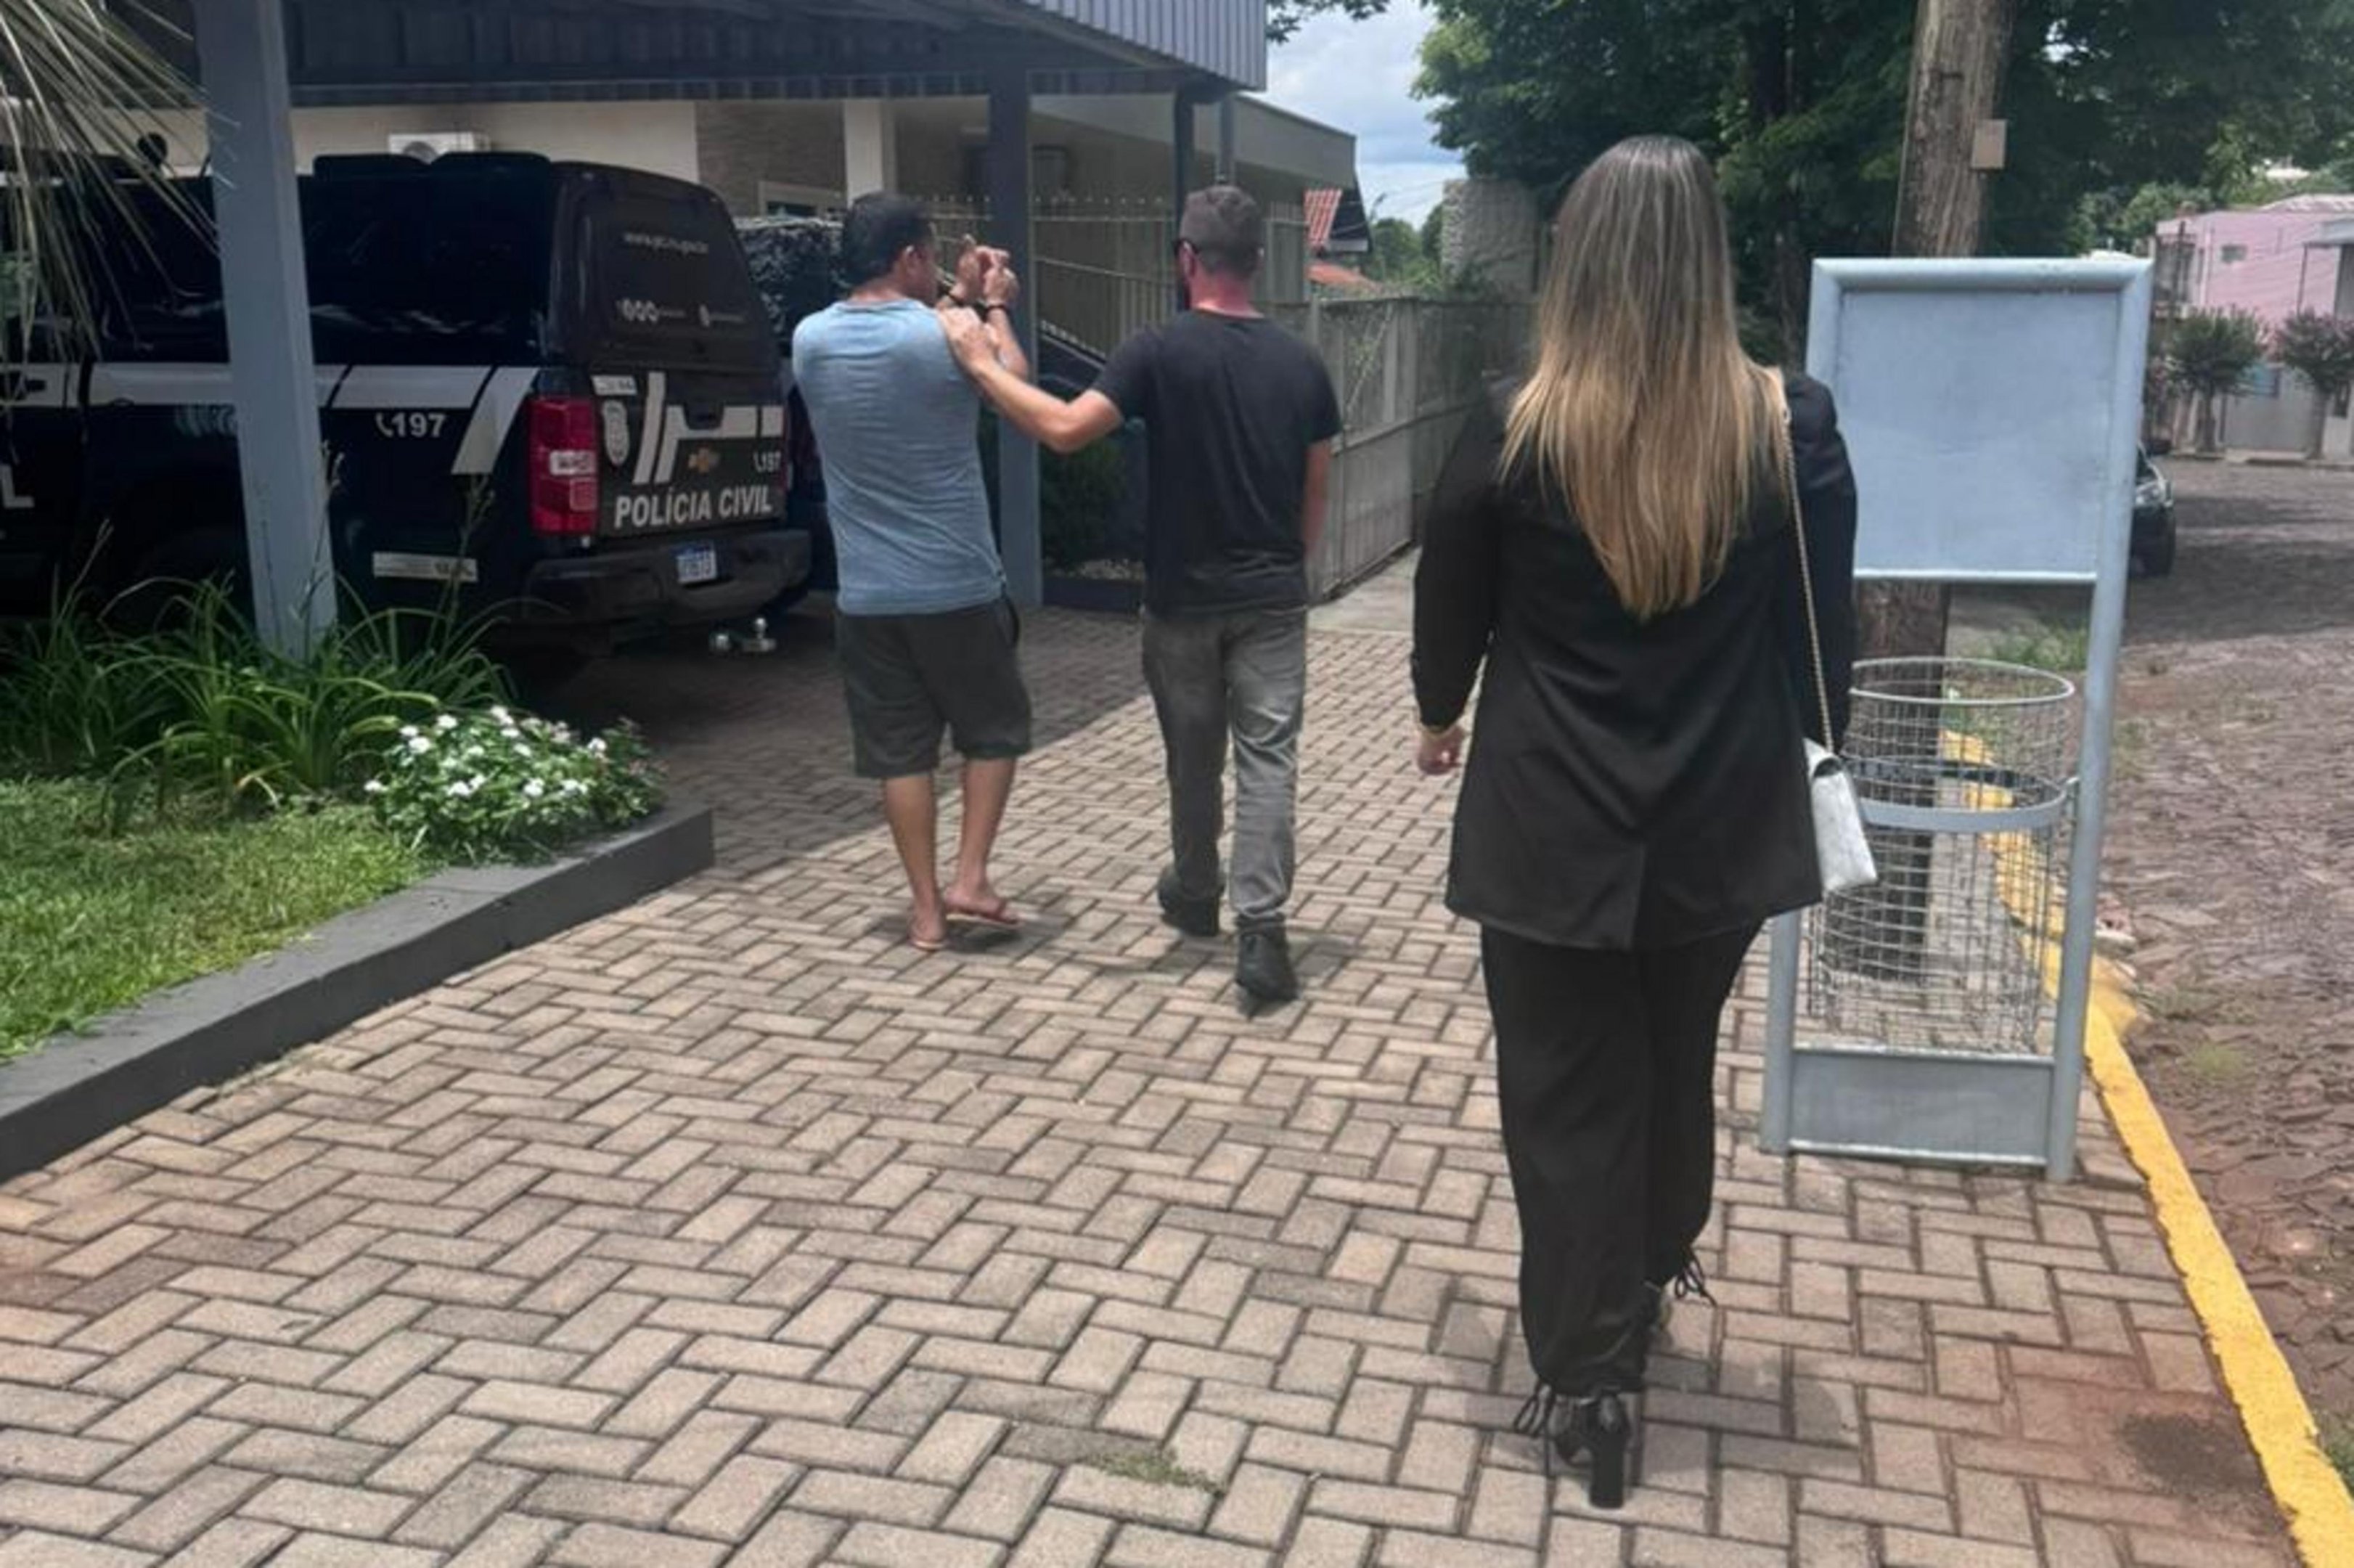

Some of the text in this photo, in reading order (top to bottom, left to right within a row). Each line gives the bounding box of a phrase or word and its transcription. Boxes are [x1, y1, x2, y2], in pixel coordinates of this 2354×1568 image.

[392, 412, 446, 437] 197
[614, 485, 772, 528] POLÍCIA CIVIL
